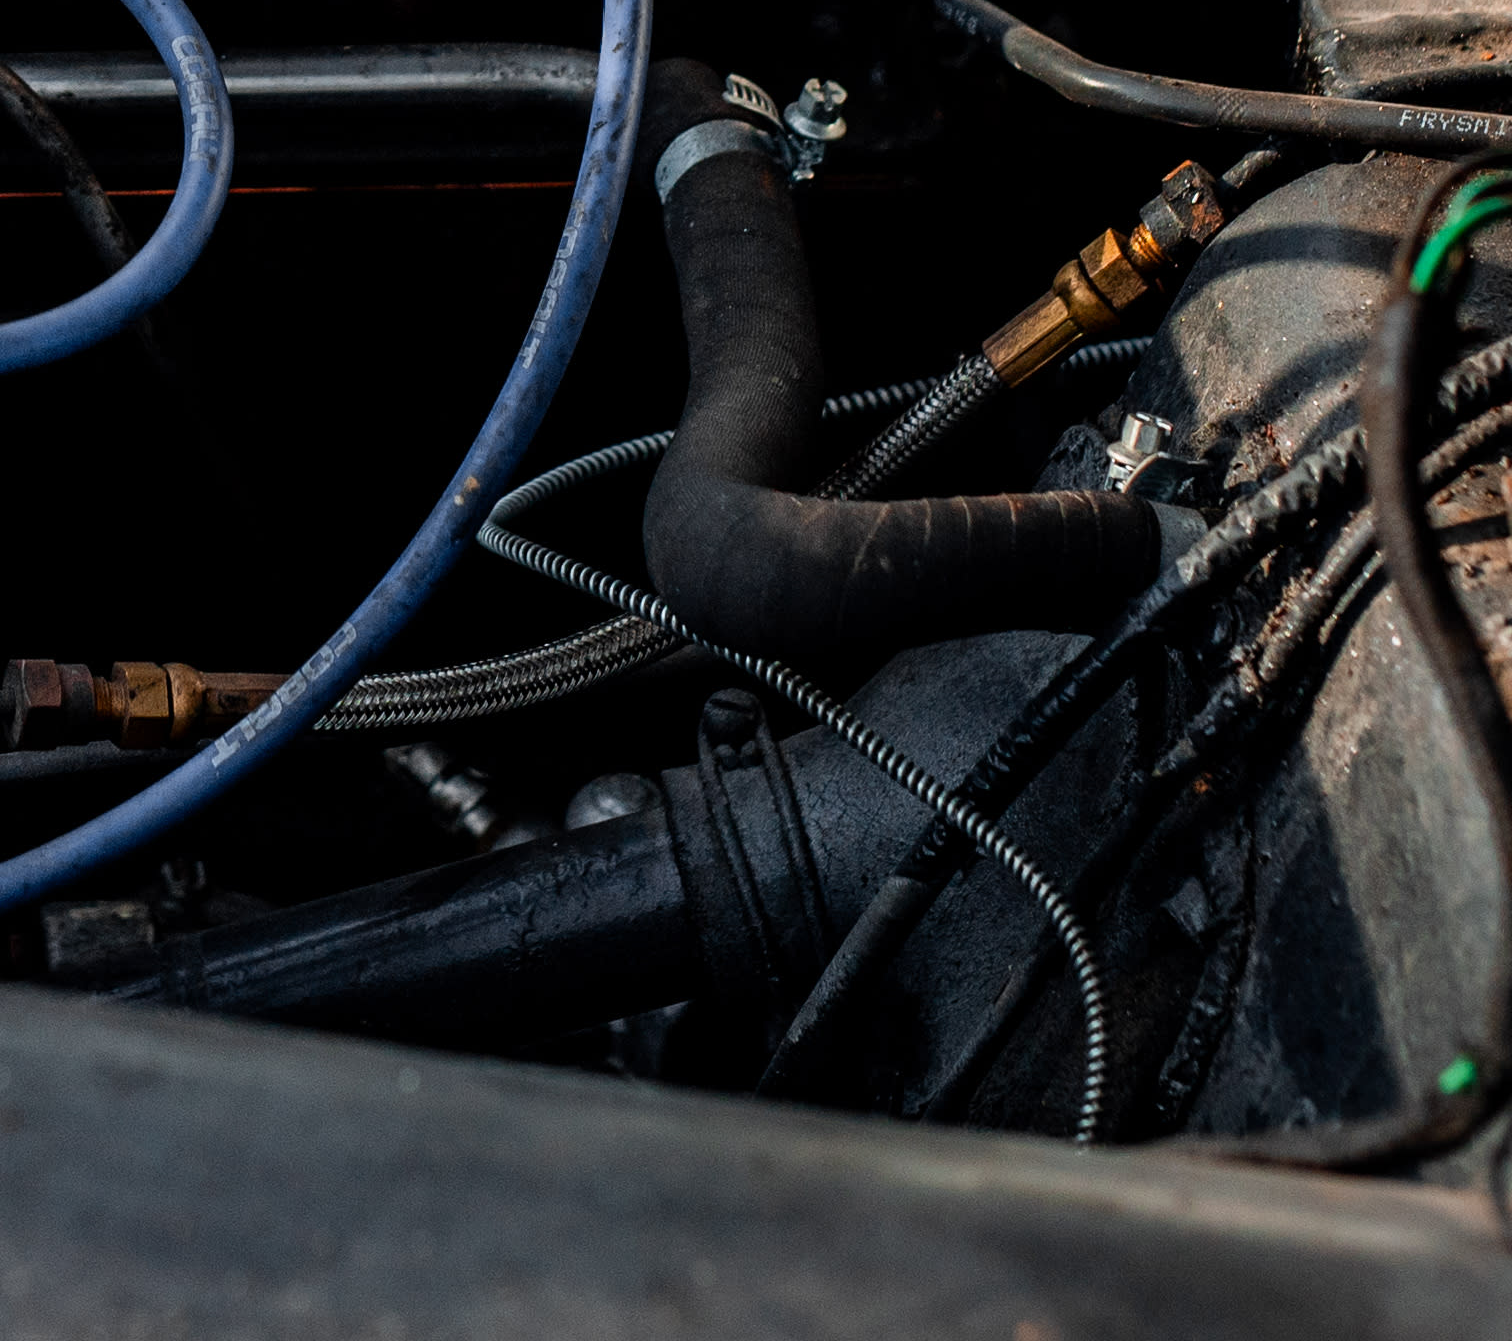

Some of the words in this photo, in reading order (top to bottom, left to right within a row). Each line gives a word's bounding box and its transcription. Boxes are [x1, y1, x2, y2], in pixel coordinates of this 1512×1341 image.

[171, 34, 222, 166] COBALT
[521, 199, 585, 370] COBALT
[211, 621, 358, 768] COBALT
